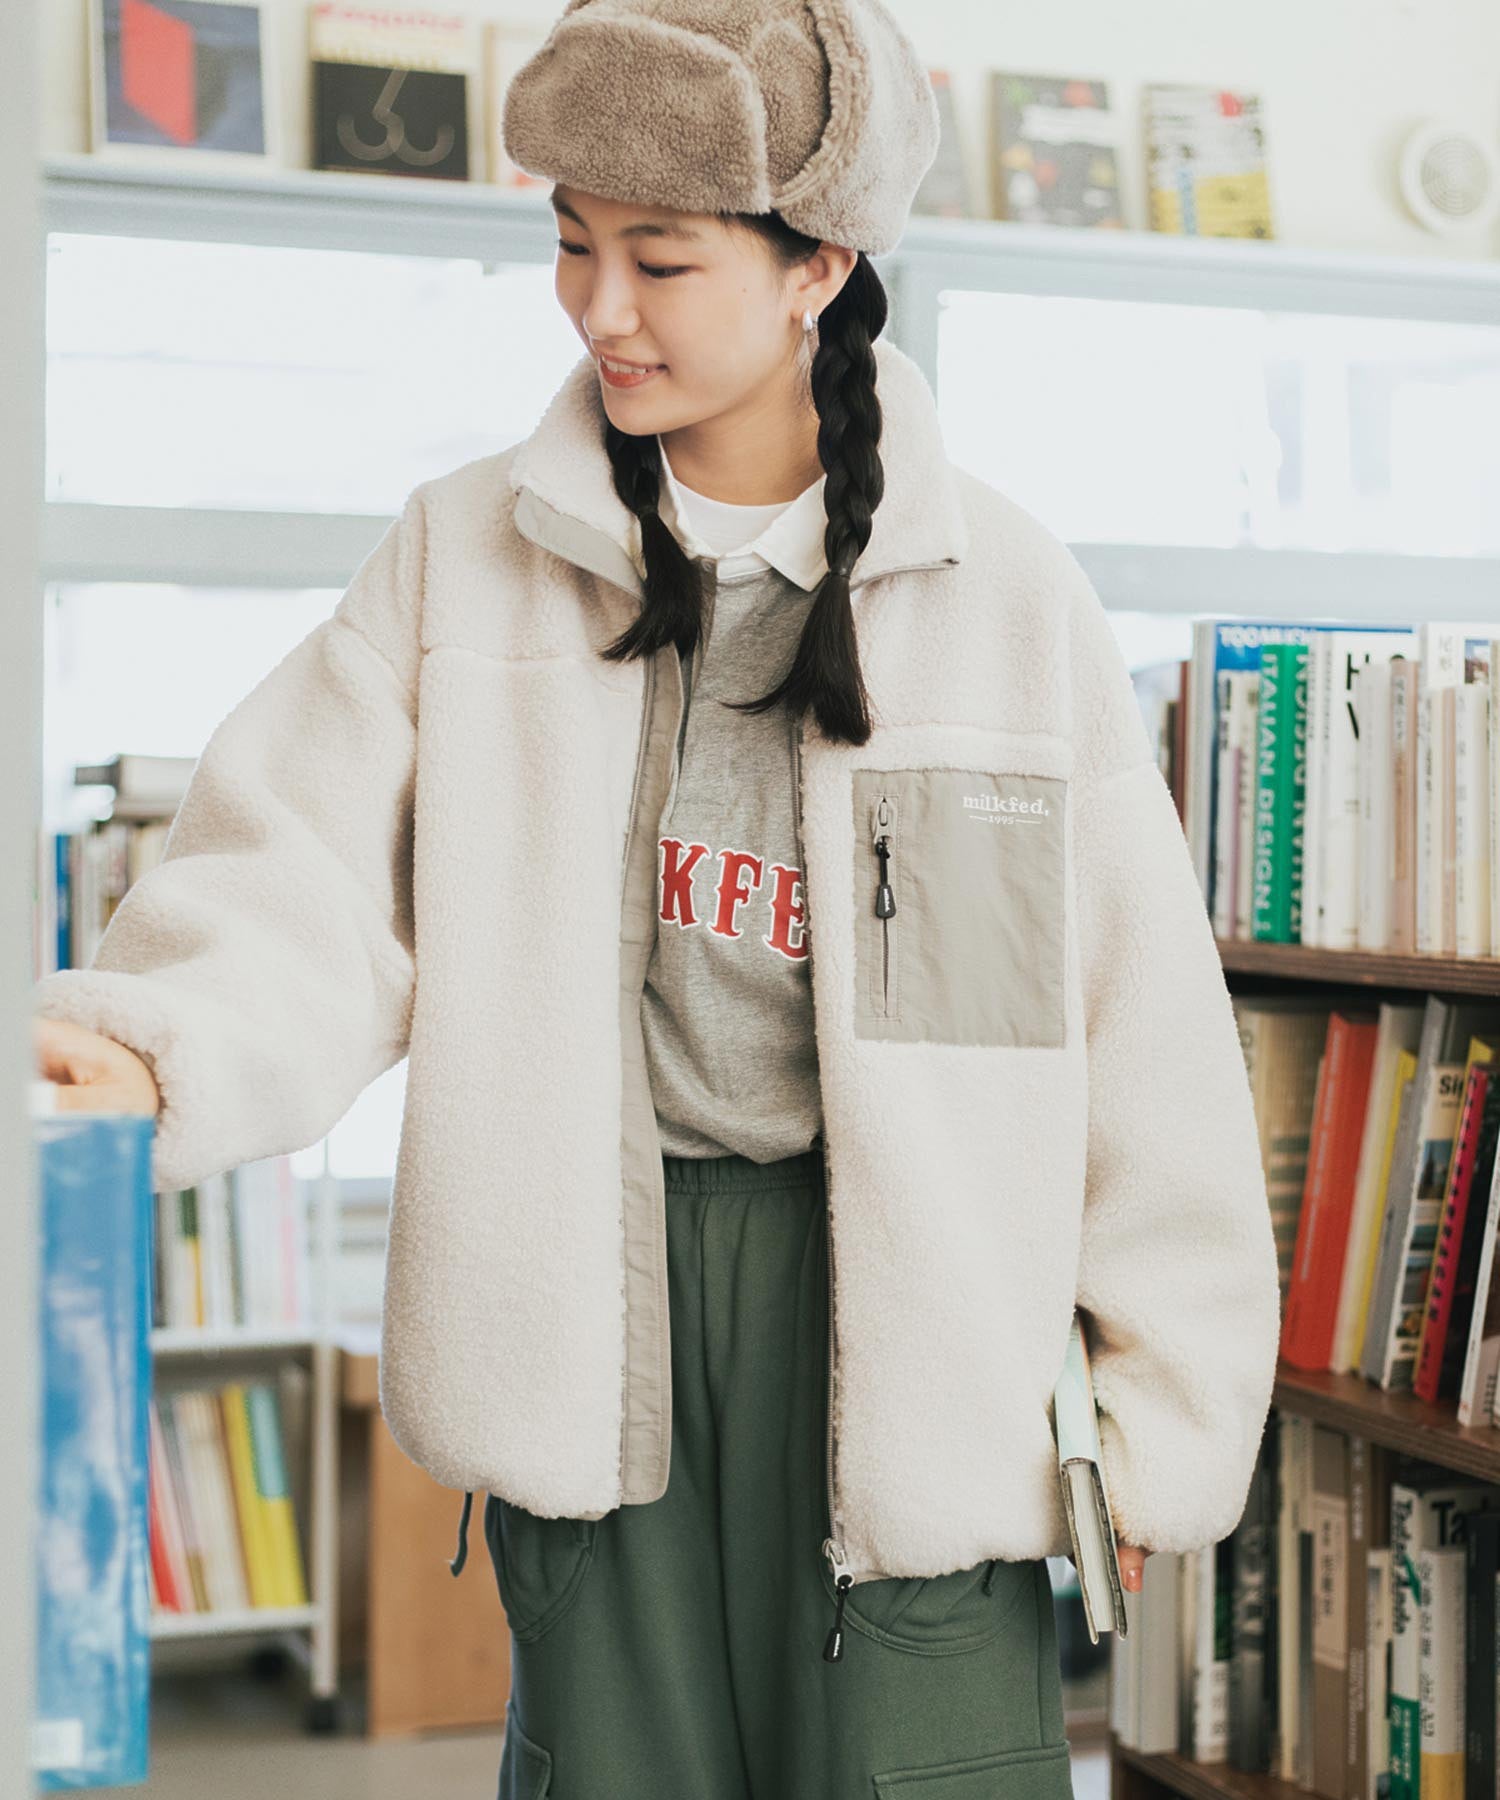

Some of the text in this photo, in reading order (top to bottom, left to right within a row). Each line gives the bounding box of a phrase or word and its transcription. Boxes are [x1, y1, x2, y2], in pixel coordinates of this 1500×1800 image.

[1259, 653, 1278, 776] ITALIAN
[962, 793, 1049, 817] milkfed.
[1255, 788, 1275, 909] DESIGN
